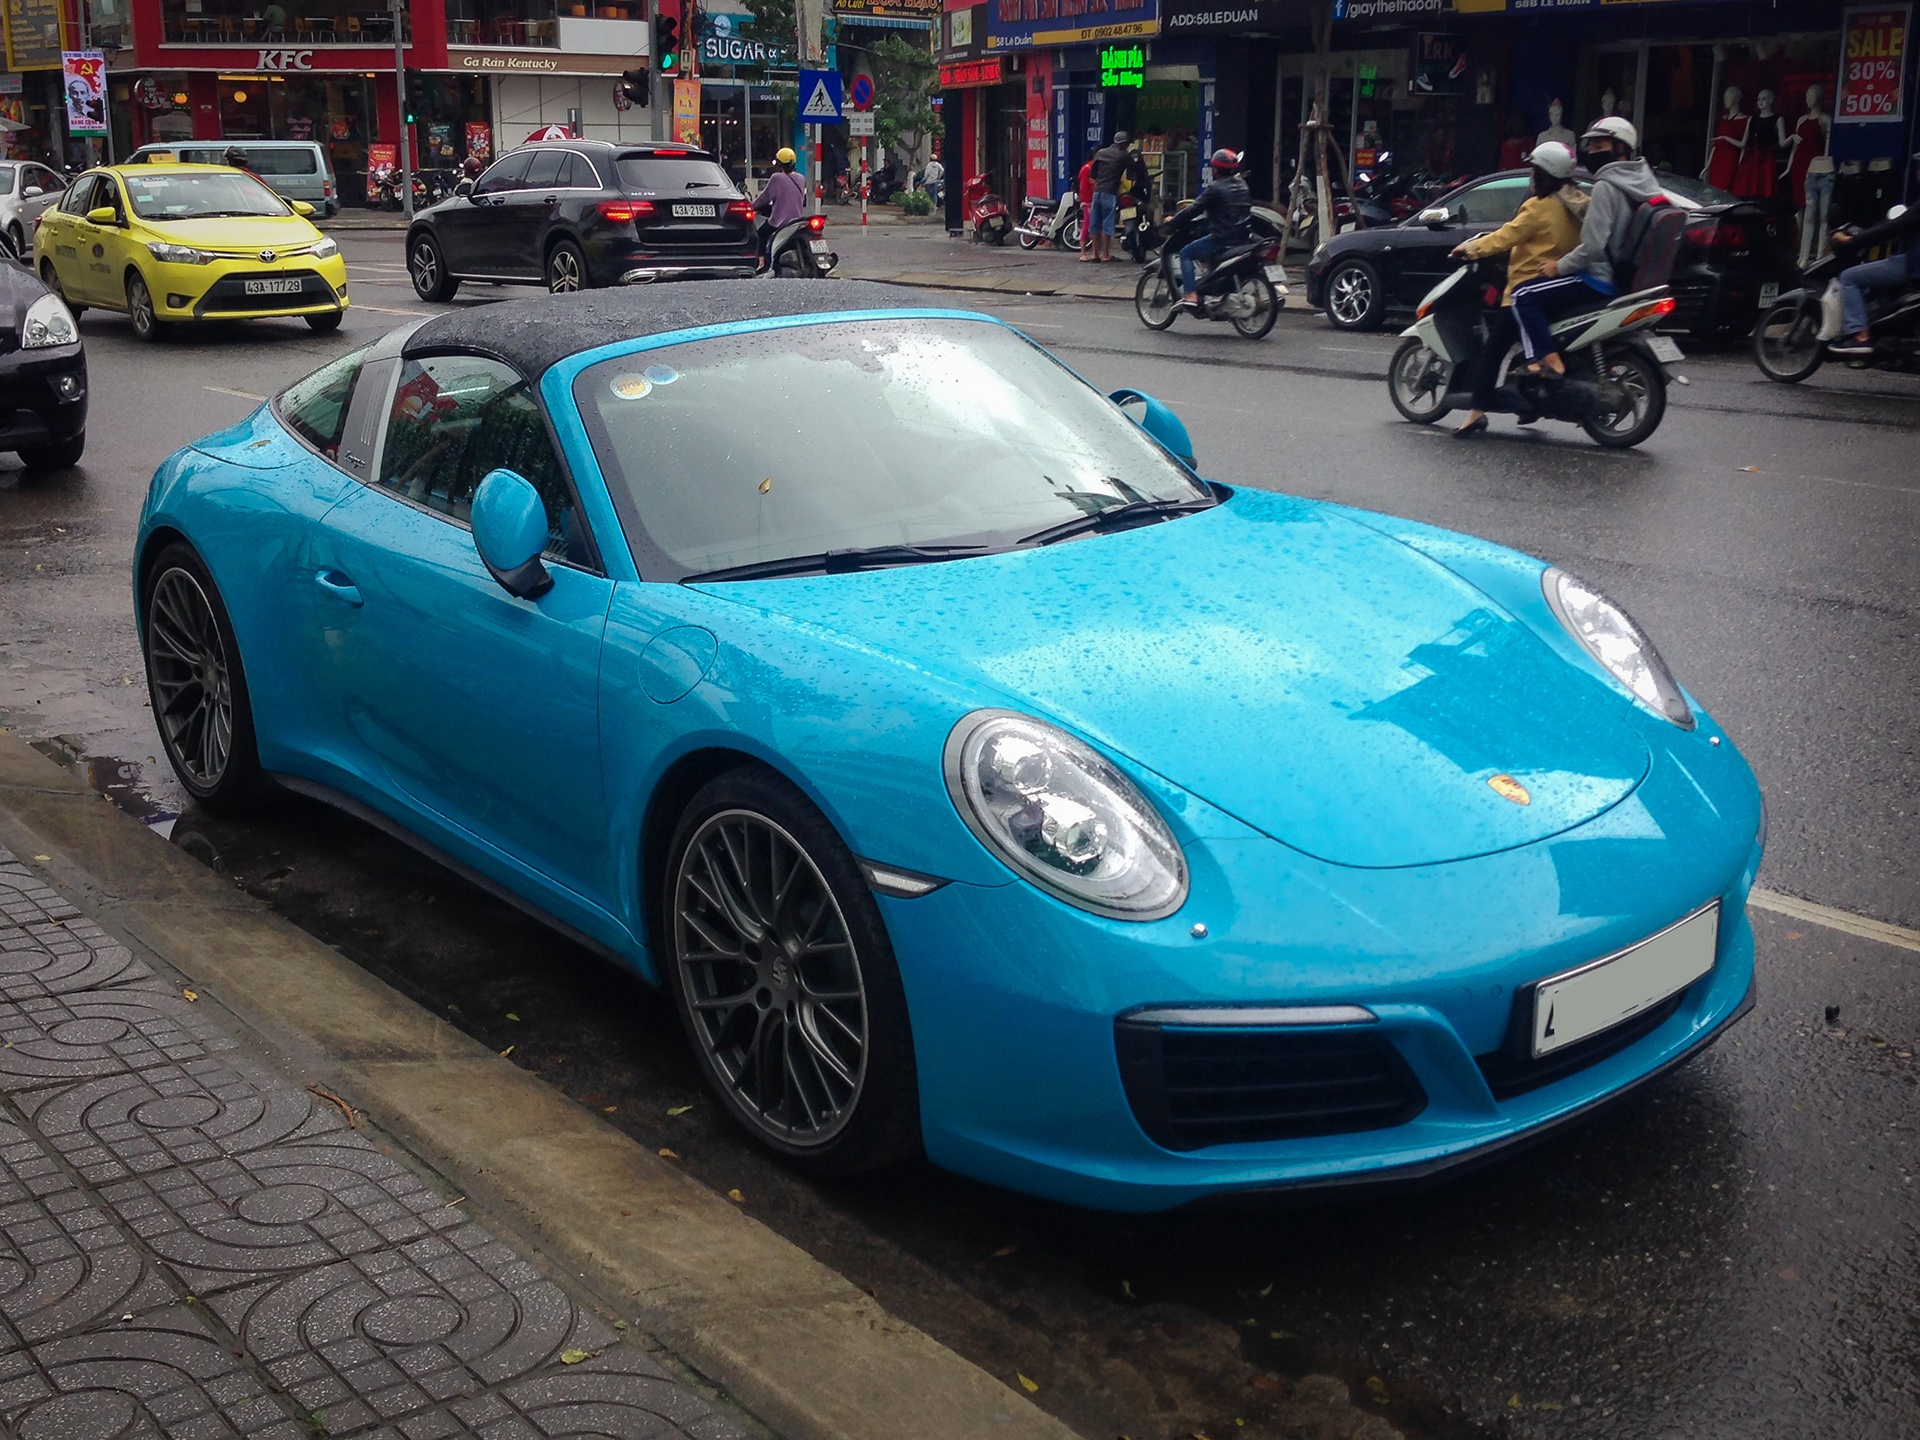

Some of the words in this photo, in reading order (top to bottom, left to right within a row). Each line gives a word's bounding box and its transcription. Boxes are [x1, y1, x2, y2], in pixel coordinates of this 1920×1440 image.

[705, 37, 766, 61] SUGAR
[1847, 27, 1904, 58] SALE
[256, 51, 313, 70] KFC
[463, 56, 479, 67] Gà
[482, 57, 505, 68] Rán
[507, 58, 558, 71] Kentucky
[1849, 61, 1896, 80] 30%
[1846, 93, 1893, 113] 50%
